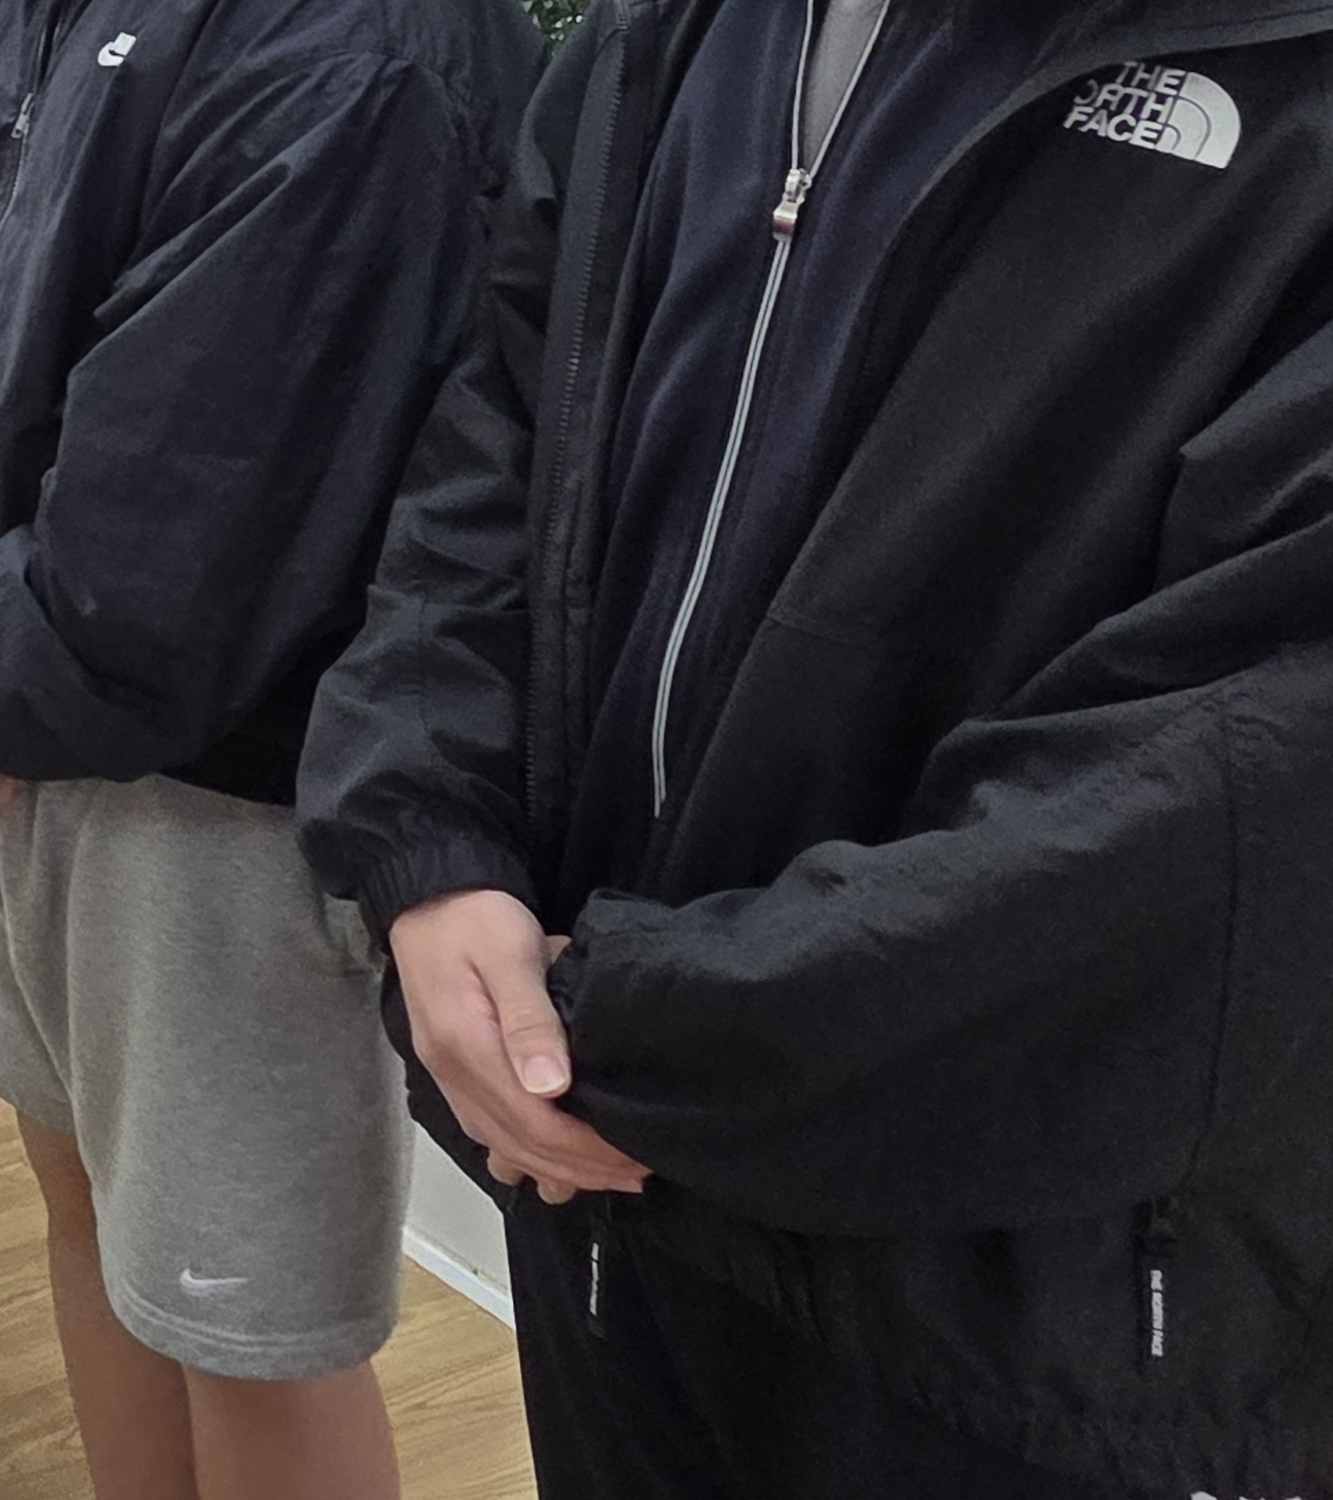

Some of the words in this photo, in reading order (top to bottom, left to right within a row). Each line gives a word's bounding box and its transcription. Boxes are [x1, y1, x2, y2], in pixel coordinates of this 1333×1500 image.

[1115, 61, 1186, 95] THE
[1074, 79, 1173, 123] ORTH
[1063, 106, 1163, 149] FACE
